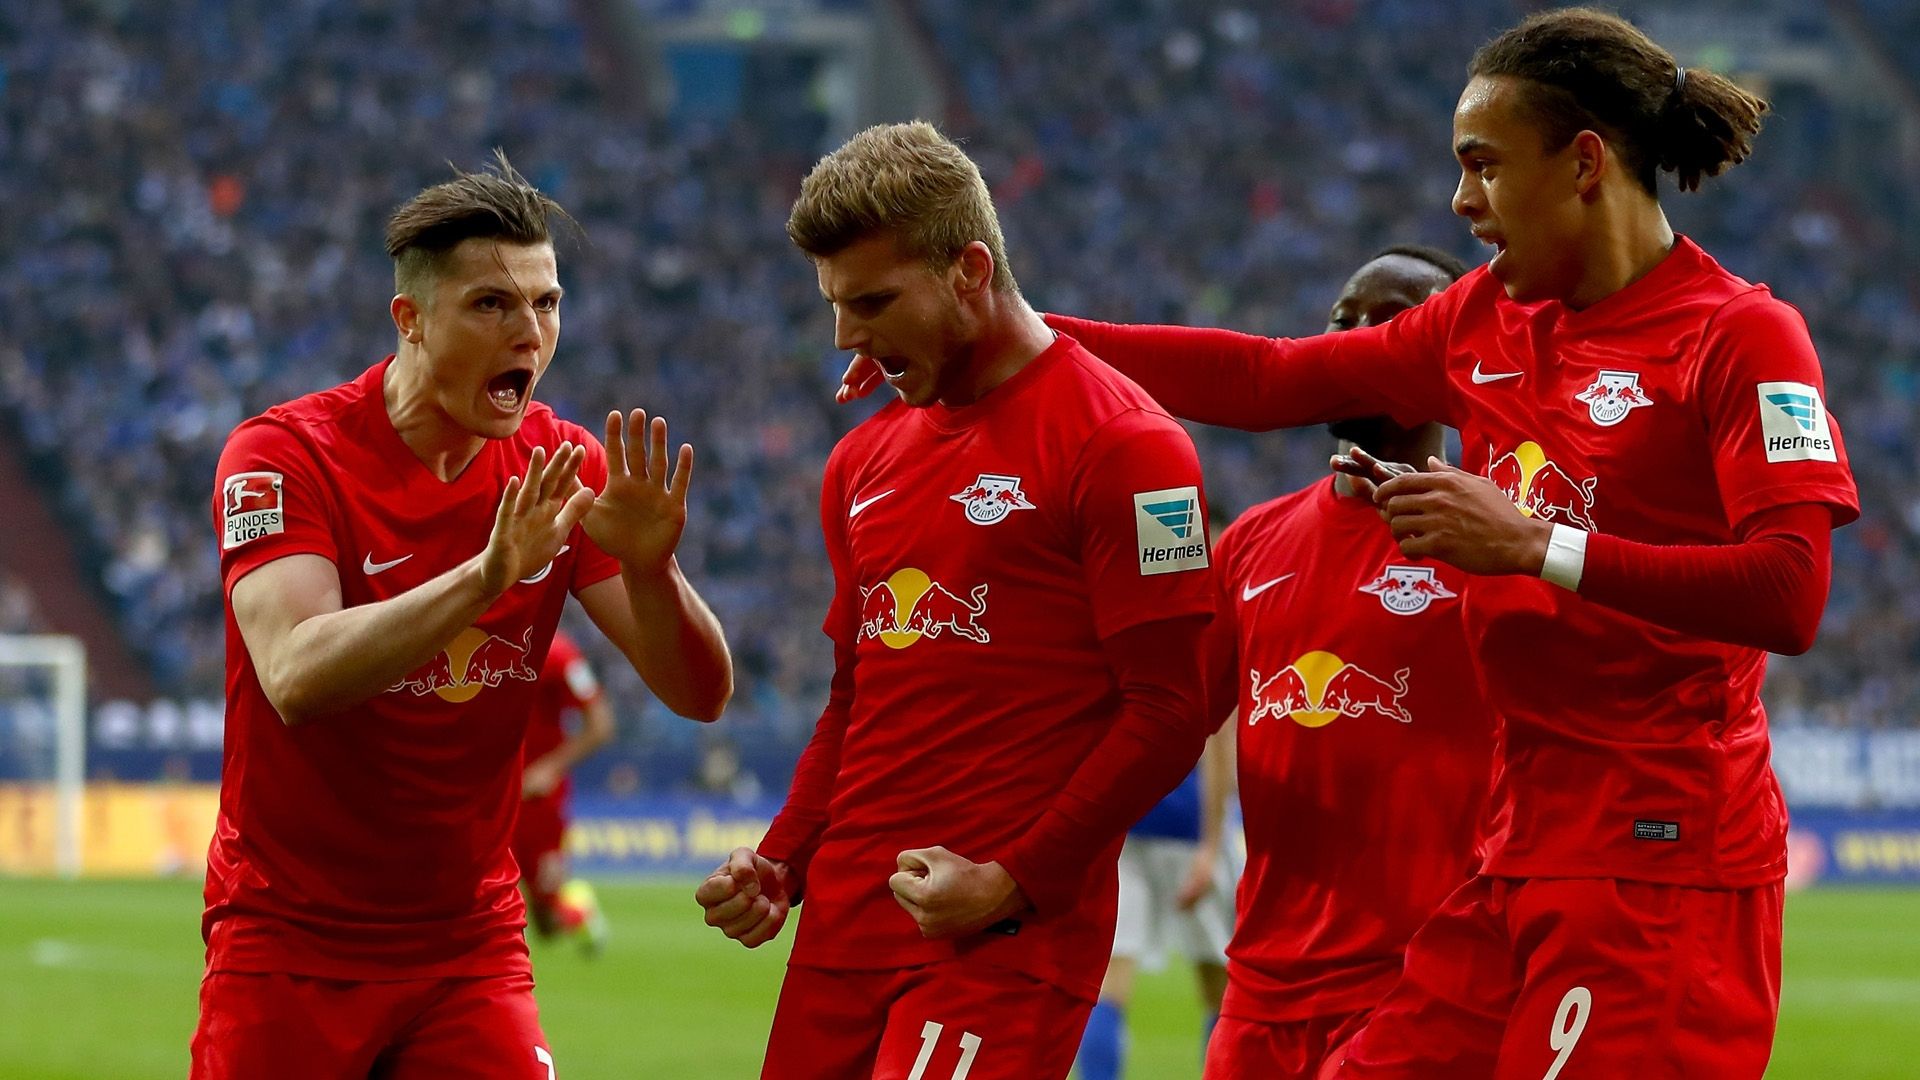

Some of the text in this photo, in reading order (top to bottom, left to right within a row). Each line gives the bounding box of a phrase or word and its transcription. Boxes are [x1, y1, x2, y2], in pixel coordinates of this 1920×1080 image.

[1769, 435, 1831, 452] Hermes
[227, 512, 280, 532] BUNDES
[234, 527, 268, 542] LIGA
[1142, 543, 1204, 563] Hermes
[1542, 986, 1592, 1080] 9
[907, 1020, 983, 1080] 11
